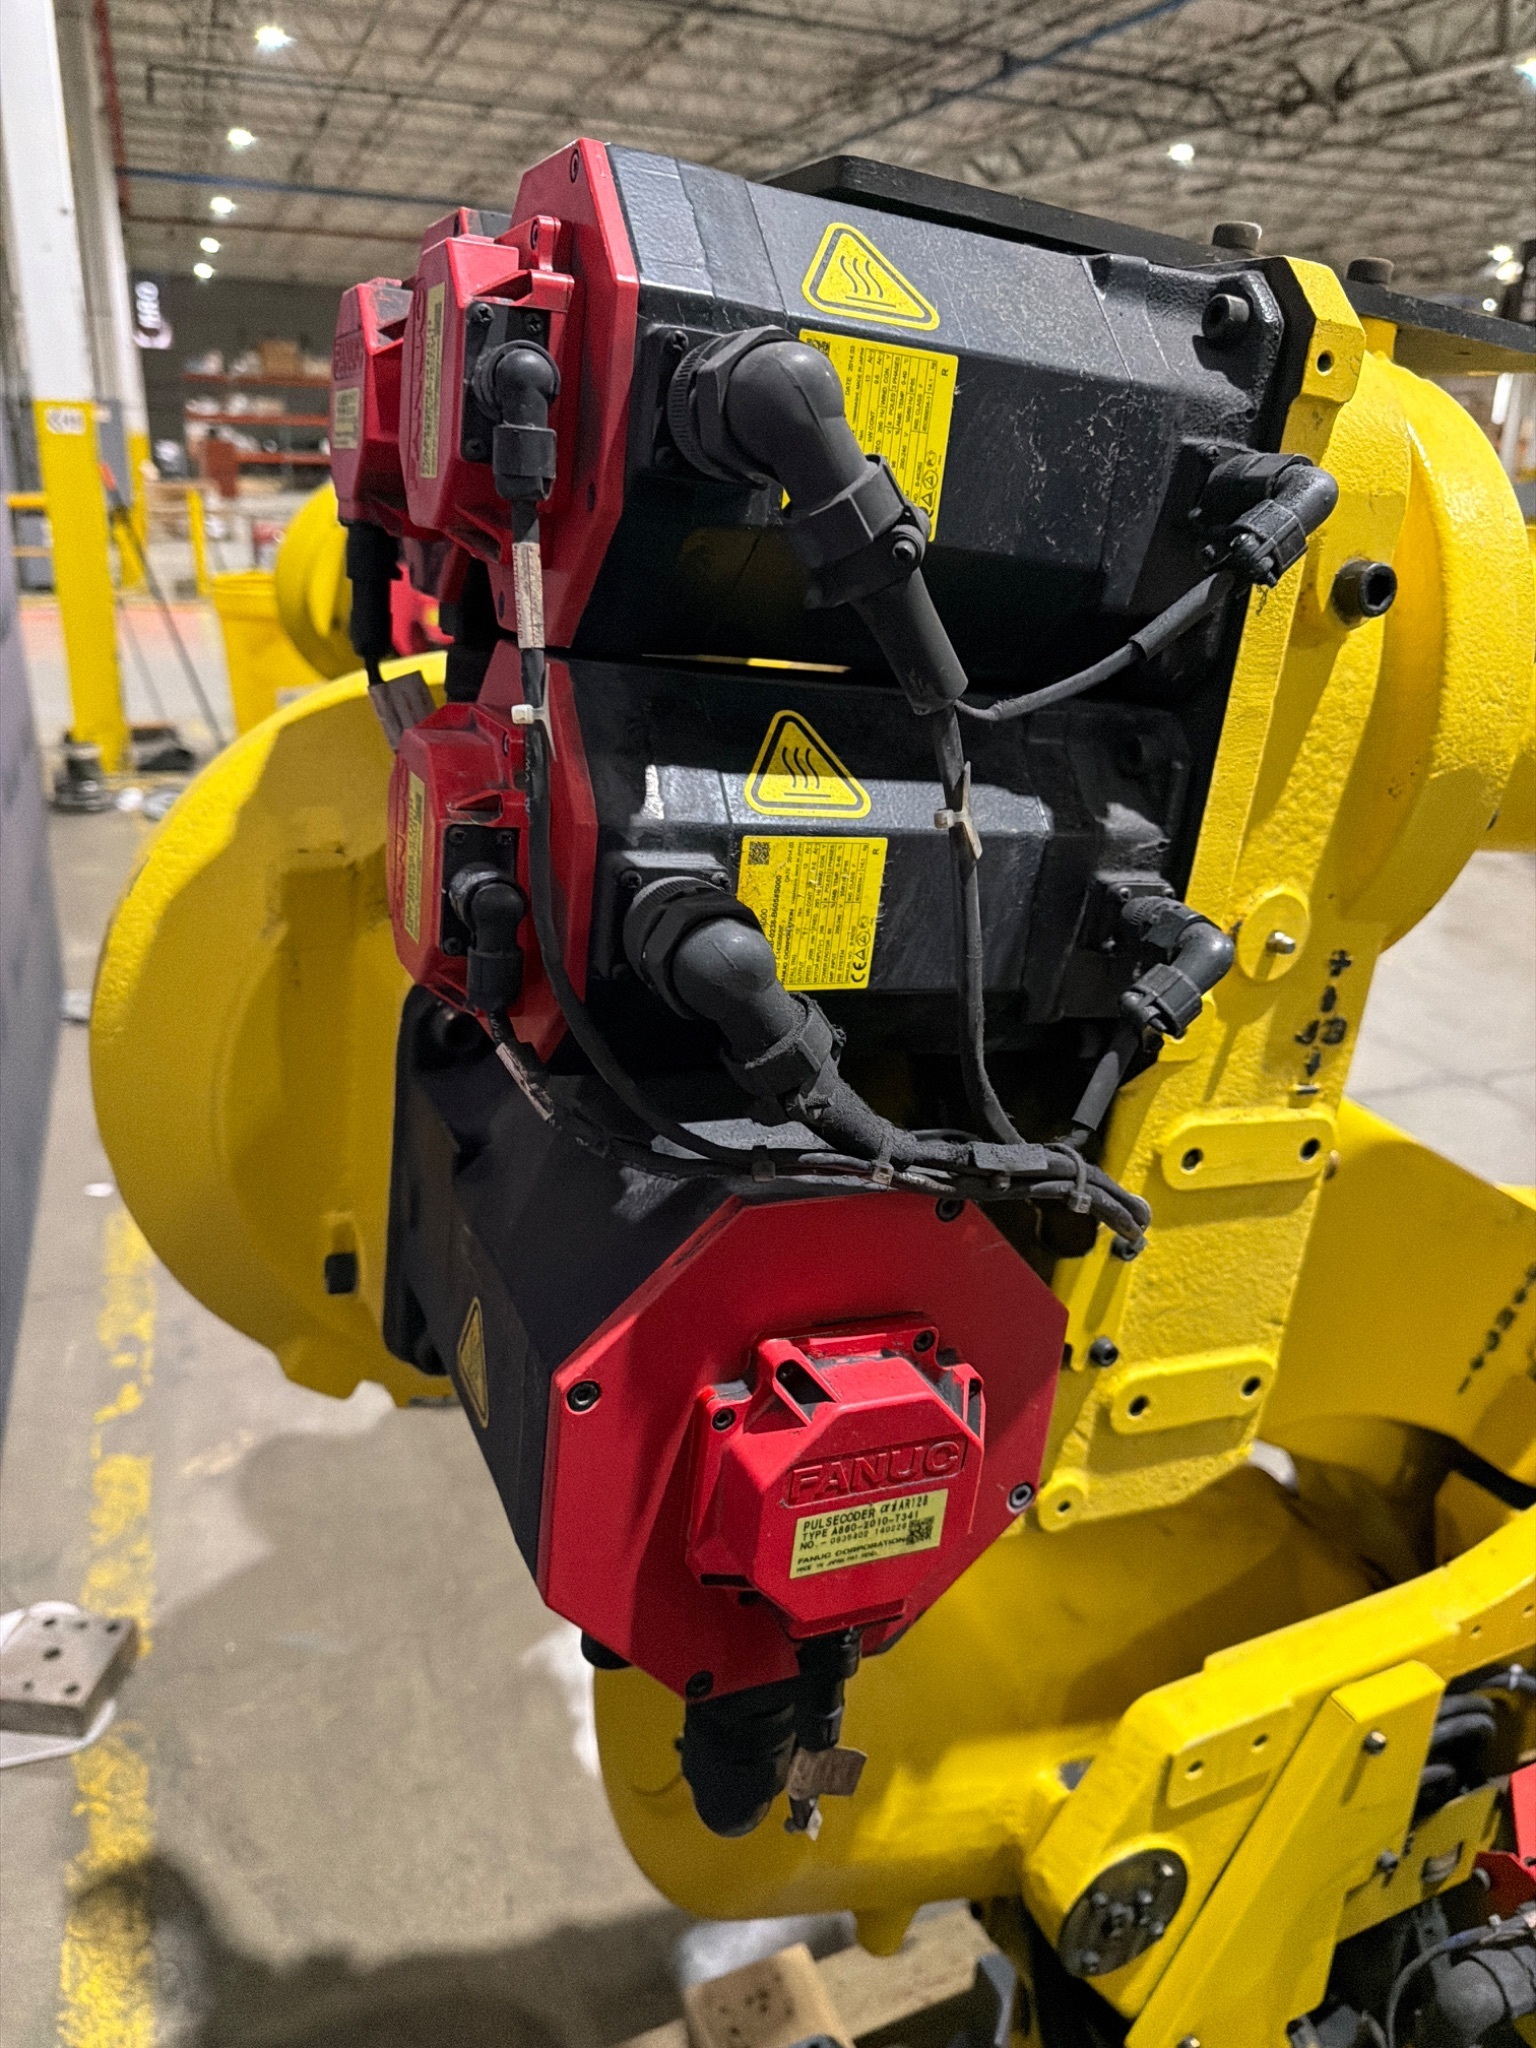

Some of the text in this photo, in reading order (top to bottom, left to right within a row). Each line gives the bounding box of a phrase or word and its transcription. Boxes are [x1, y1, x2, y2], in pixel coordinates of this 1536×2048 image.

[940, 368, 948, 376] R
[887, 392, 895, 415] POLES
[891, 356, 900, 383] PHASES
[914, 393, 922, 415] CLASS
[858, 429, 863, 440] Nm
[790, 1441, 960, 1500] FANUC
[803, 1508, 876, 1532] PULSECODER
[802, 1528, 828, 1541] TYPE
[797, 1537, 906, 1565] FANUC CORPORATION
